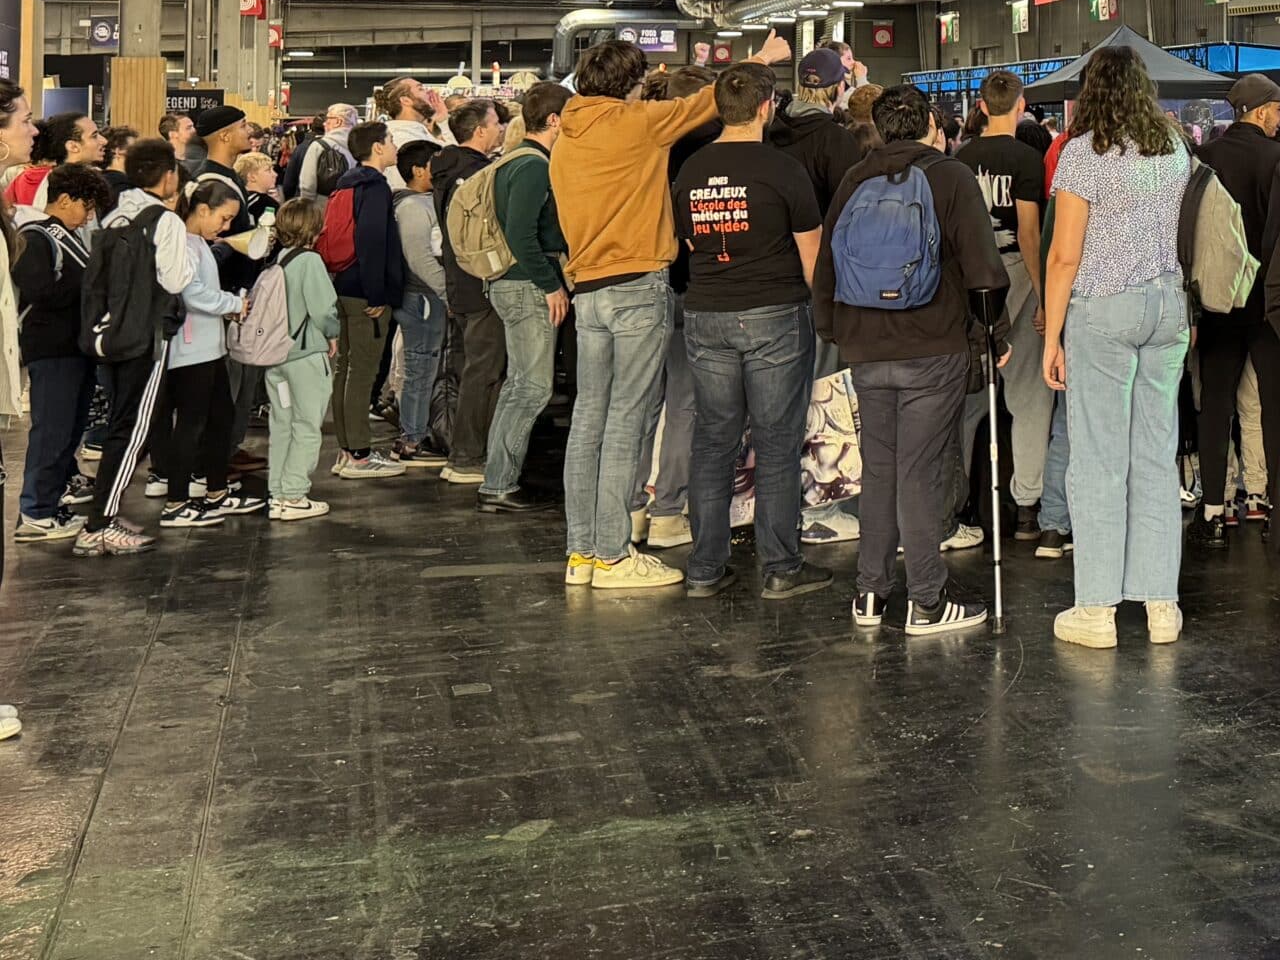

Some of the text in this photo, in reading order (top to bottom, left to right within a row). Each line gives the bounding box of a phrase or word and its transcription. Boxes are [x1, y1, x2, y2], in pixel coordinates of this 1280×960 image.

[166, 96, 197, 109] EGEND
[689, 187, 747, 200] CREAJEUX
[690, 199, 747, 211] L'école des
[691, 209, 748, 222] métiers du
[693, 220, 749, 236] jeu vidéo
